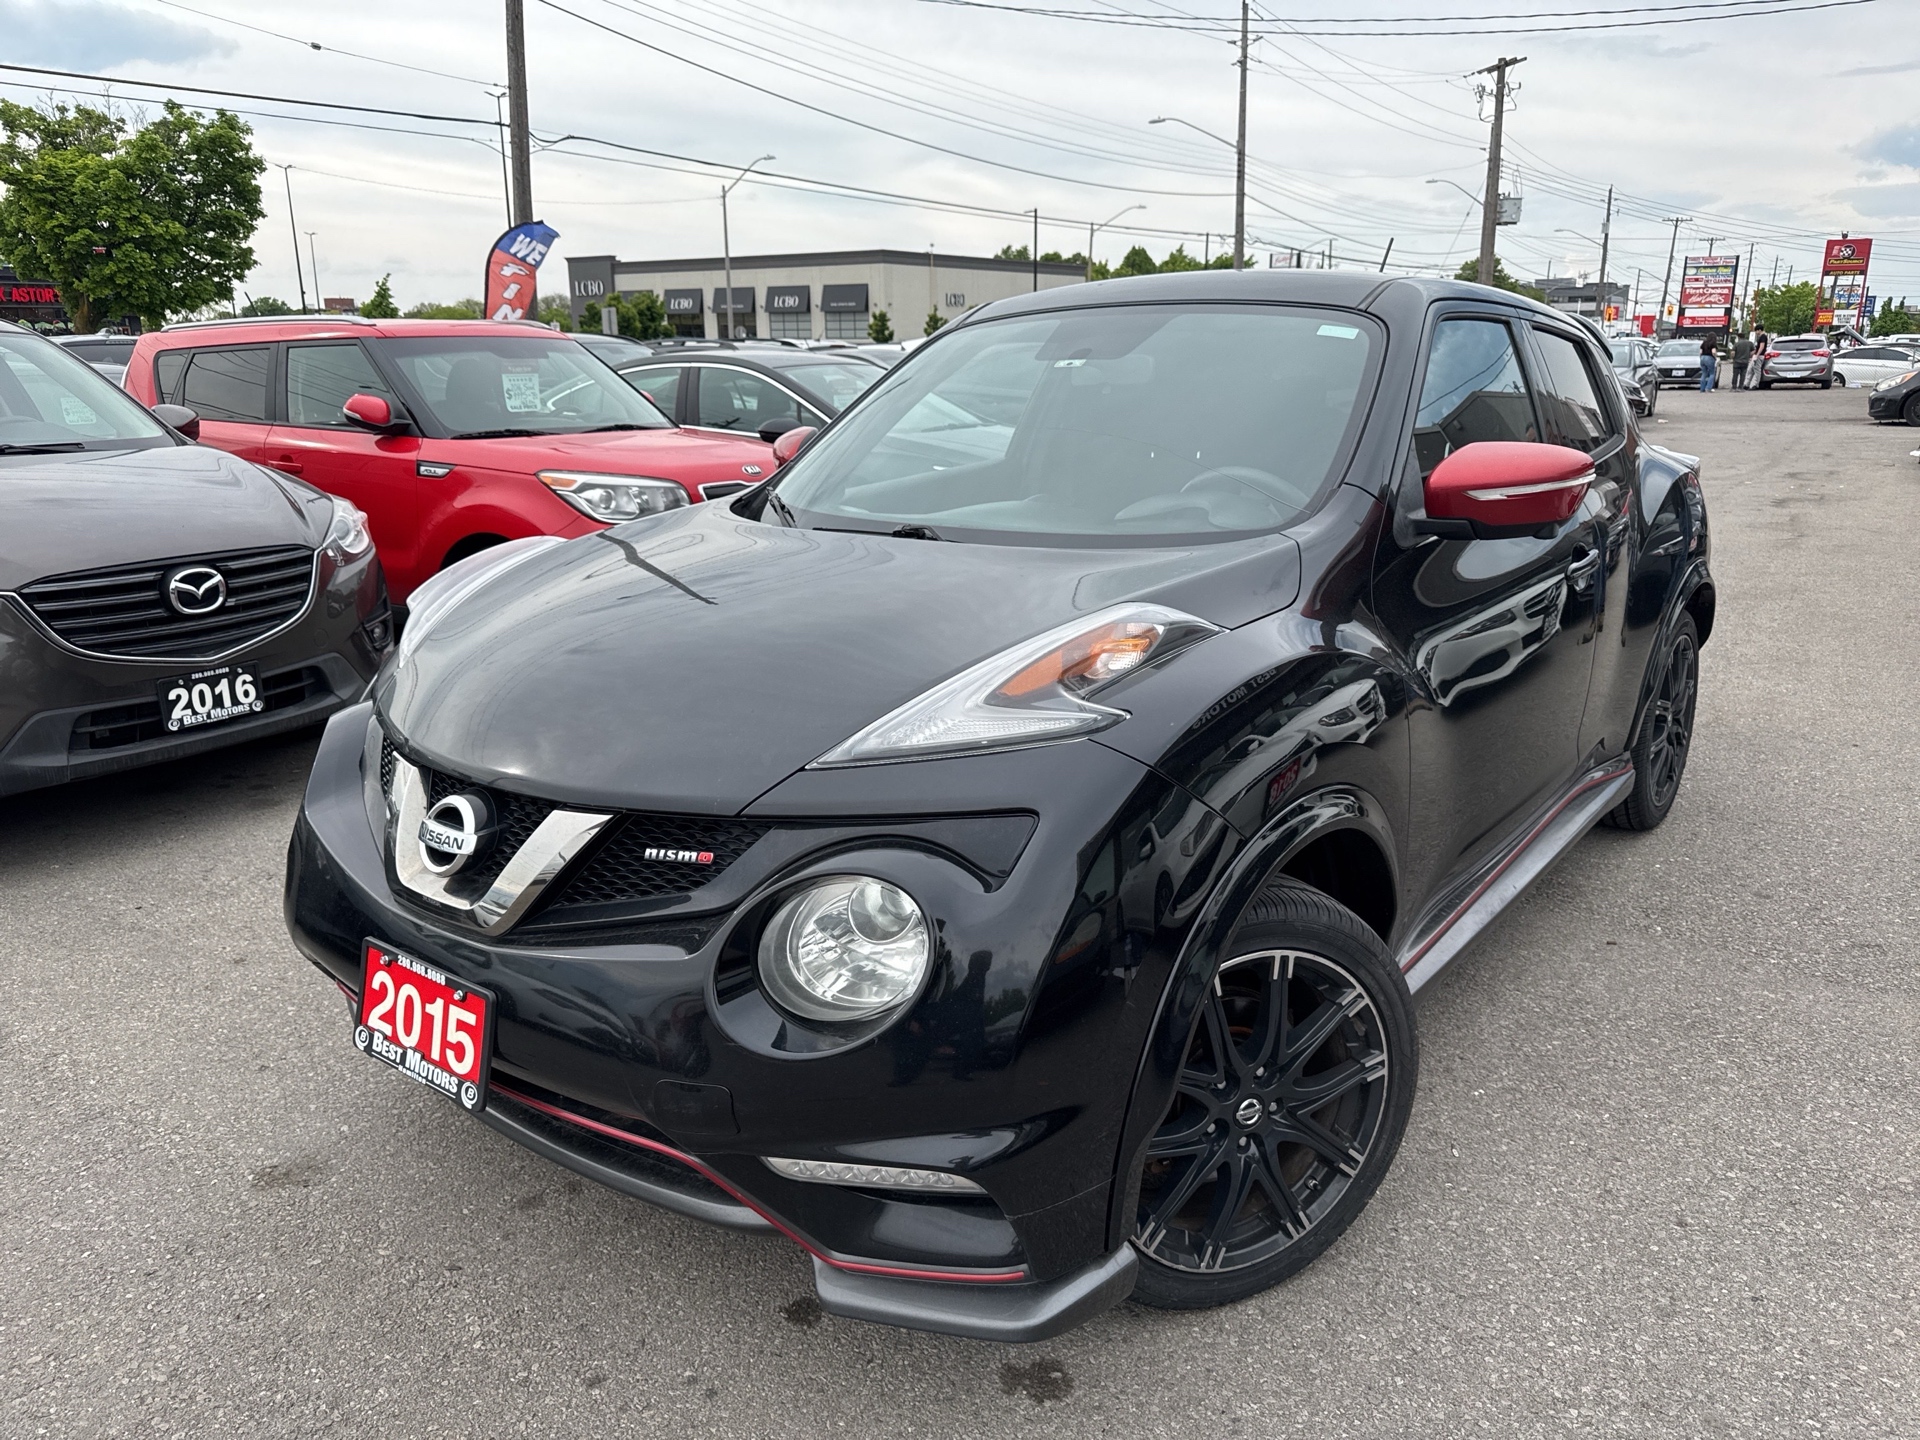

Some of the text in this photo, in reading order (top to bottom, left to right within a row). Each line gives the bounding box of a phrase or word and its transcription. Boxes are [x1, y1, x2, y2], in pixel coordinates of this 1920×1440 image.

[509, 233, 549, 266] WE
[575, 280, 604, 297] LCBO
[774, 296, 799, 308] LCBO
[670, 298, 693, 310] LCBO
[168, 673, 257, 720] 2016
[183, 715, 208, 726] BEST
[210, 703, 251, 719] MOTORS
[420, 822, 465, 851] NISSAN
[367, 970, 477, 1075] 2015
[372, 1030, 459, 1093] BEST MOTORS
